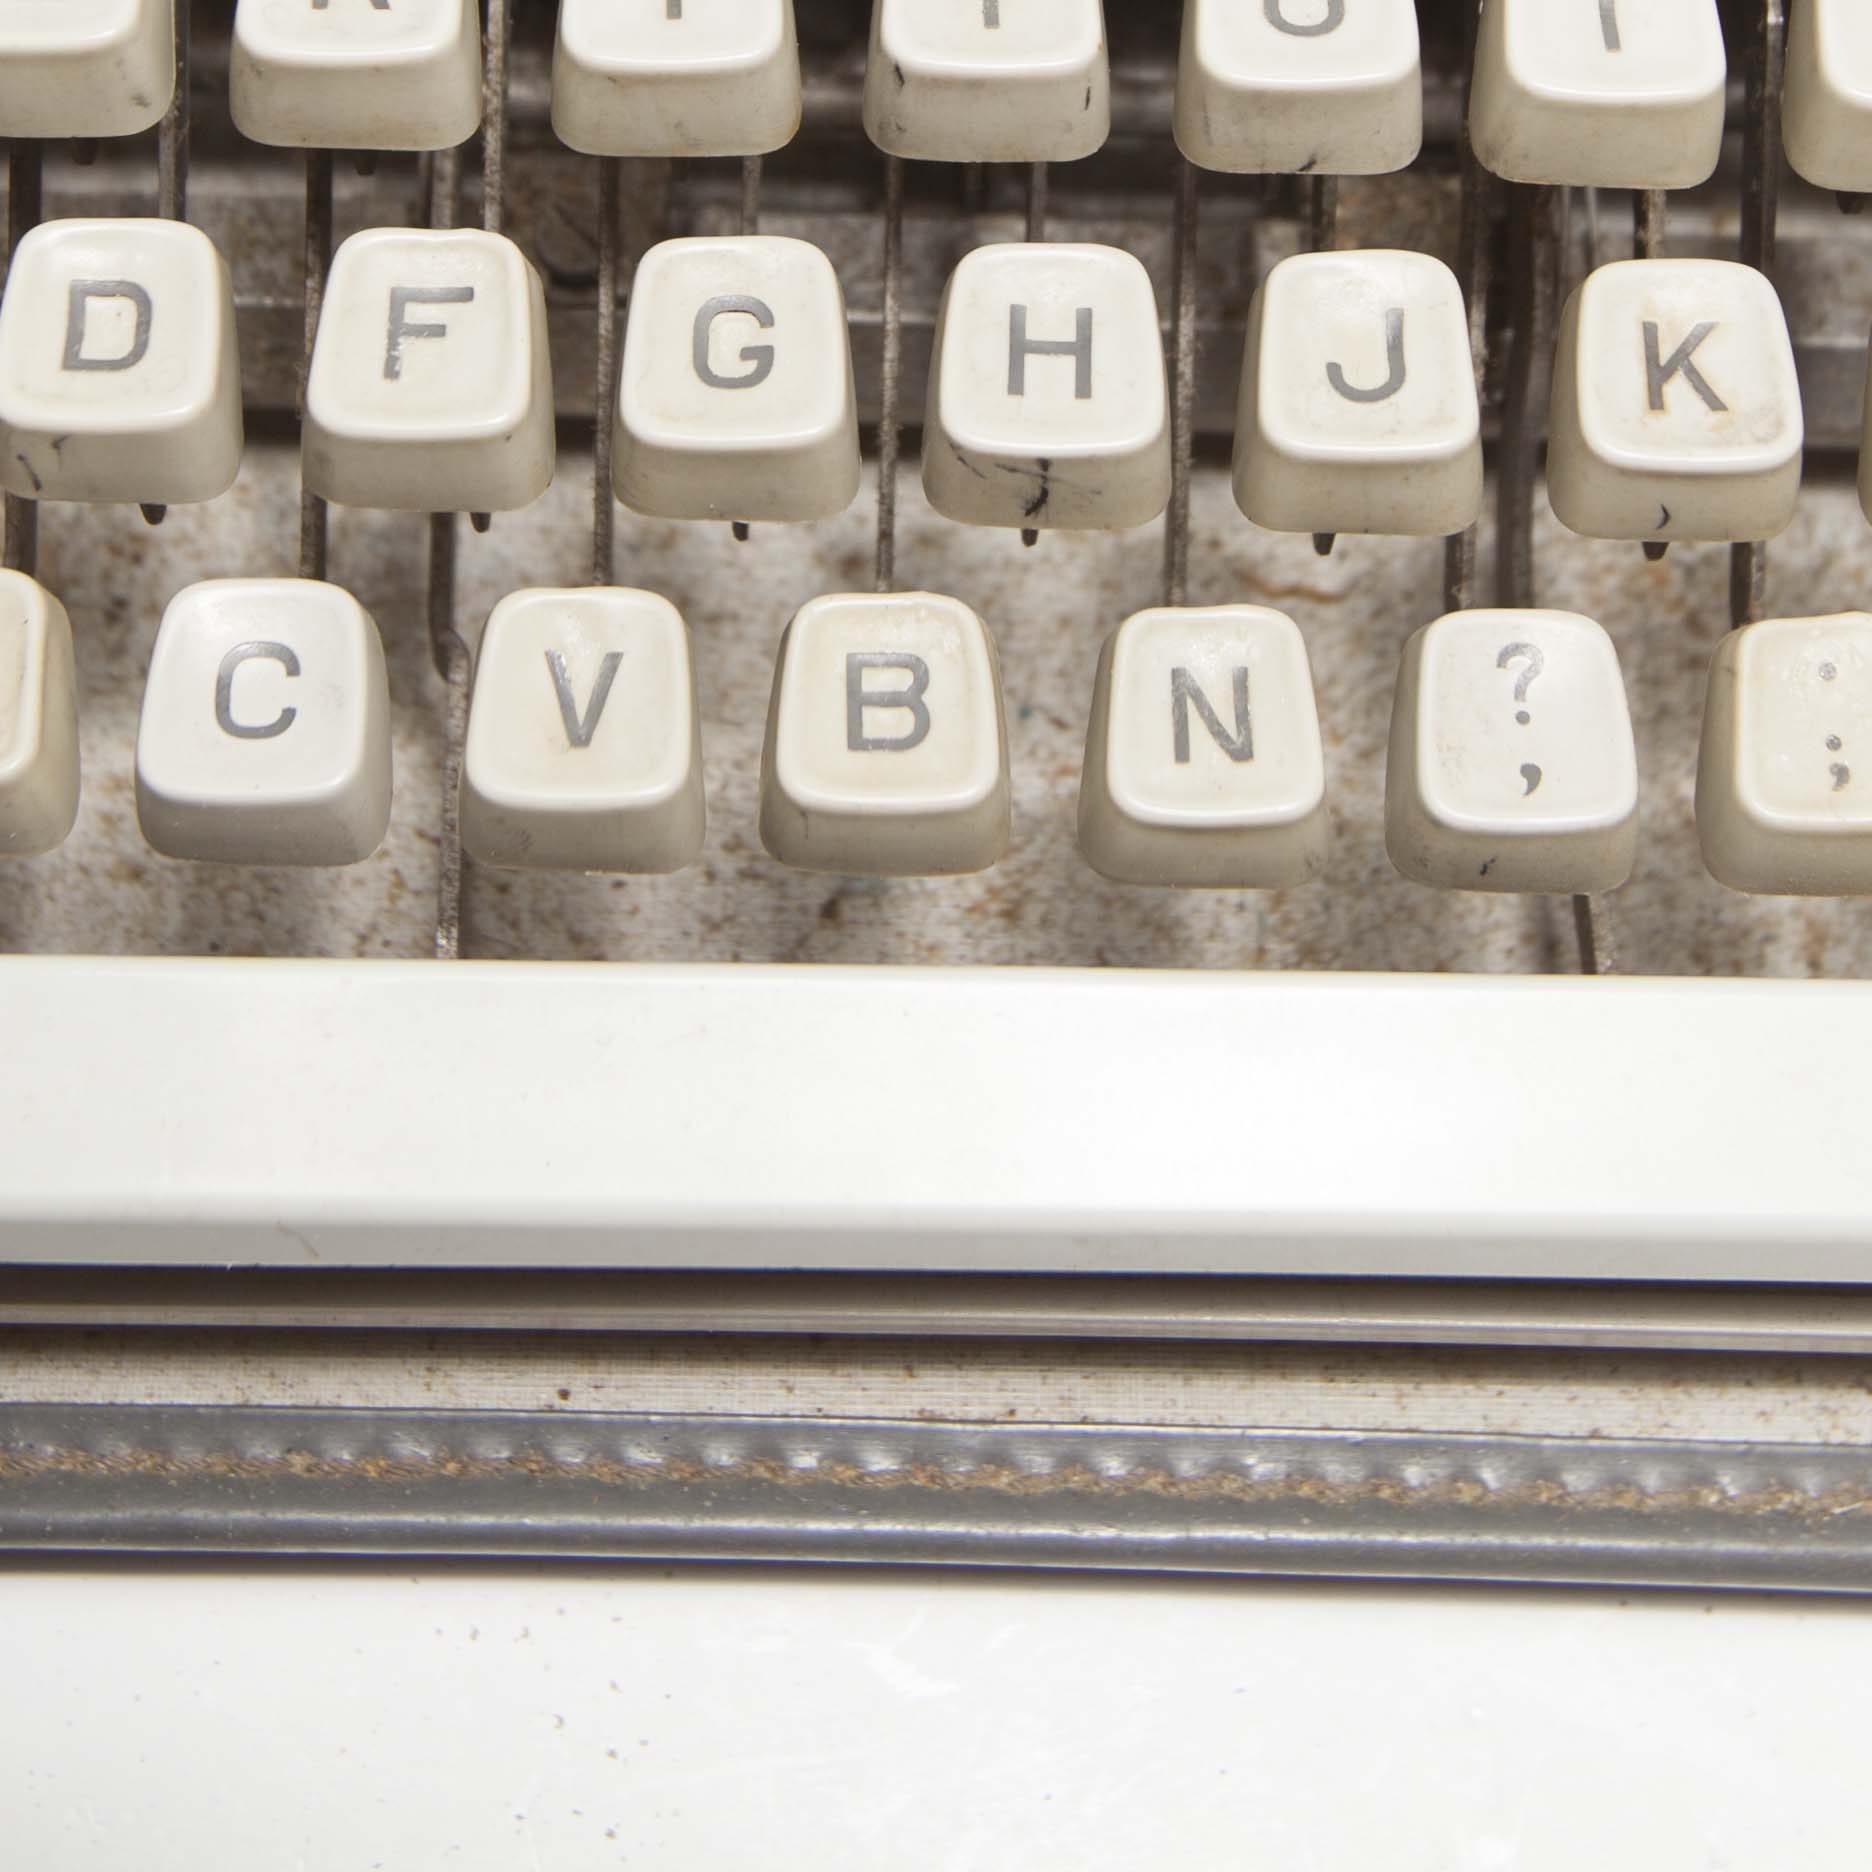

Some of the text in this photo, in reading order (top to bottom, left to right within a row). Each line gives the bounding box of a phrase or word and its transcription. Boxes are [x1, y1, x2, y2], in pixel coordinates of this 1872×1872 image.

[59, 278, 155, 374] D
[381, 284, 476, 383] F
[690, 294, 777, 392] G
[1005, 302, 1094, 401] H
[1324, 307, 1408, 405] J
[1640, 319, 1730, 414] K
[213, 640, 303, 742] C
[543, 649, 625, 751] V
[844, 651, 933, 754] B
[1169, 665, 1256, 766] N
[1494, 640, 1545, 728] ?
